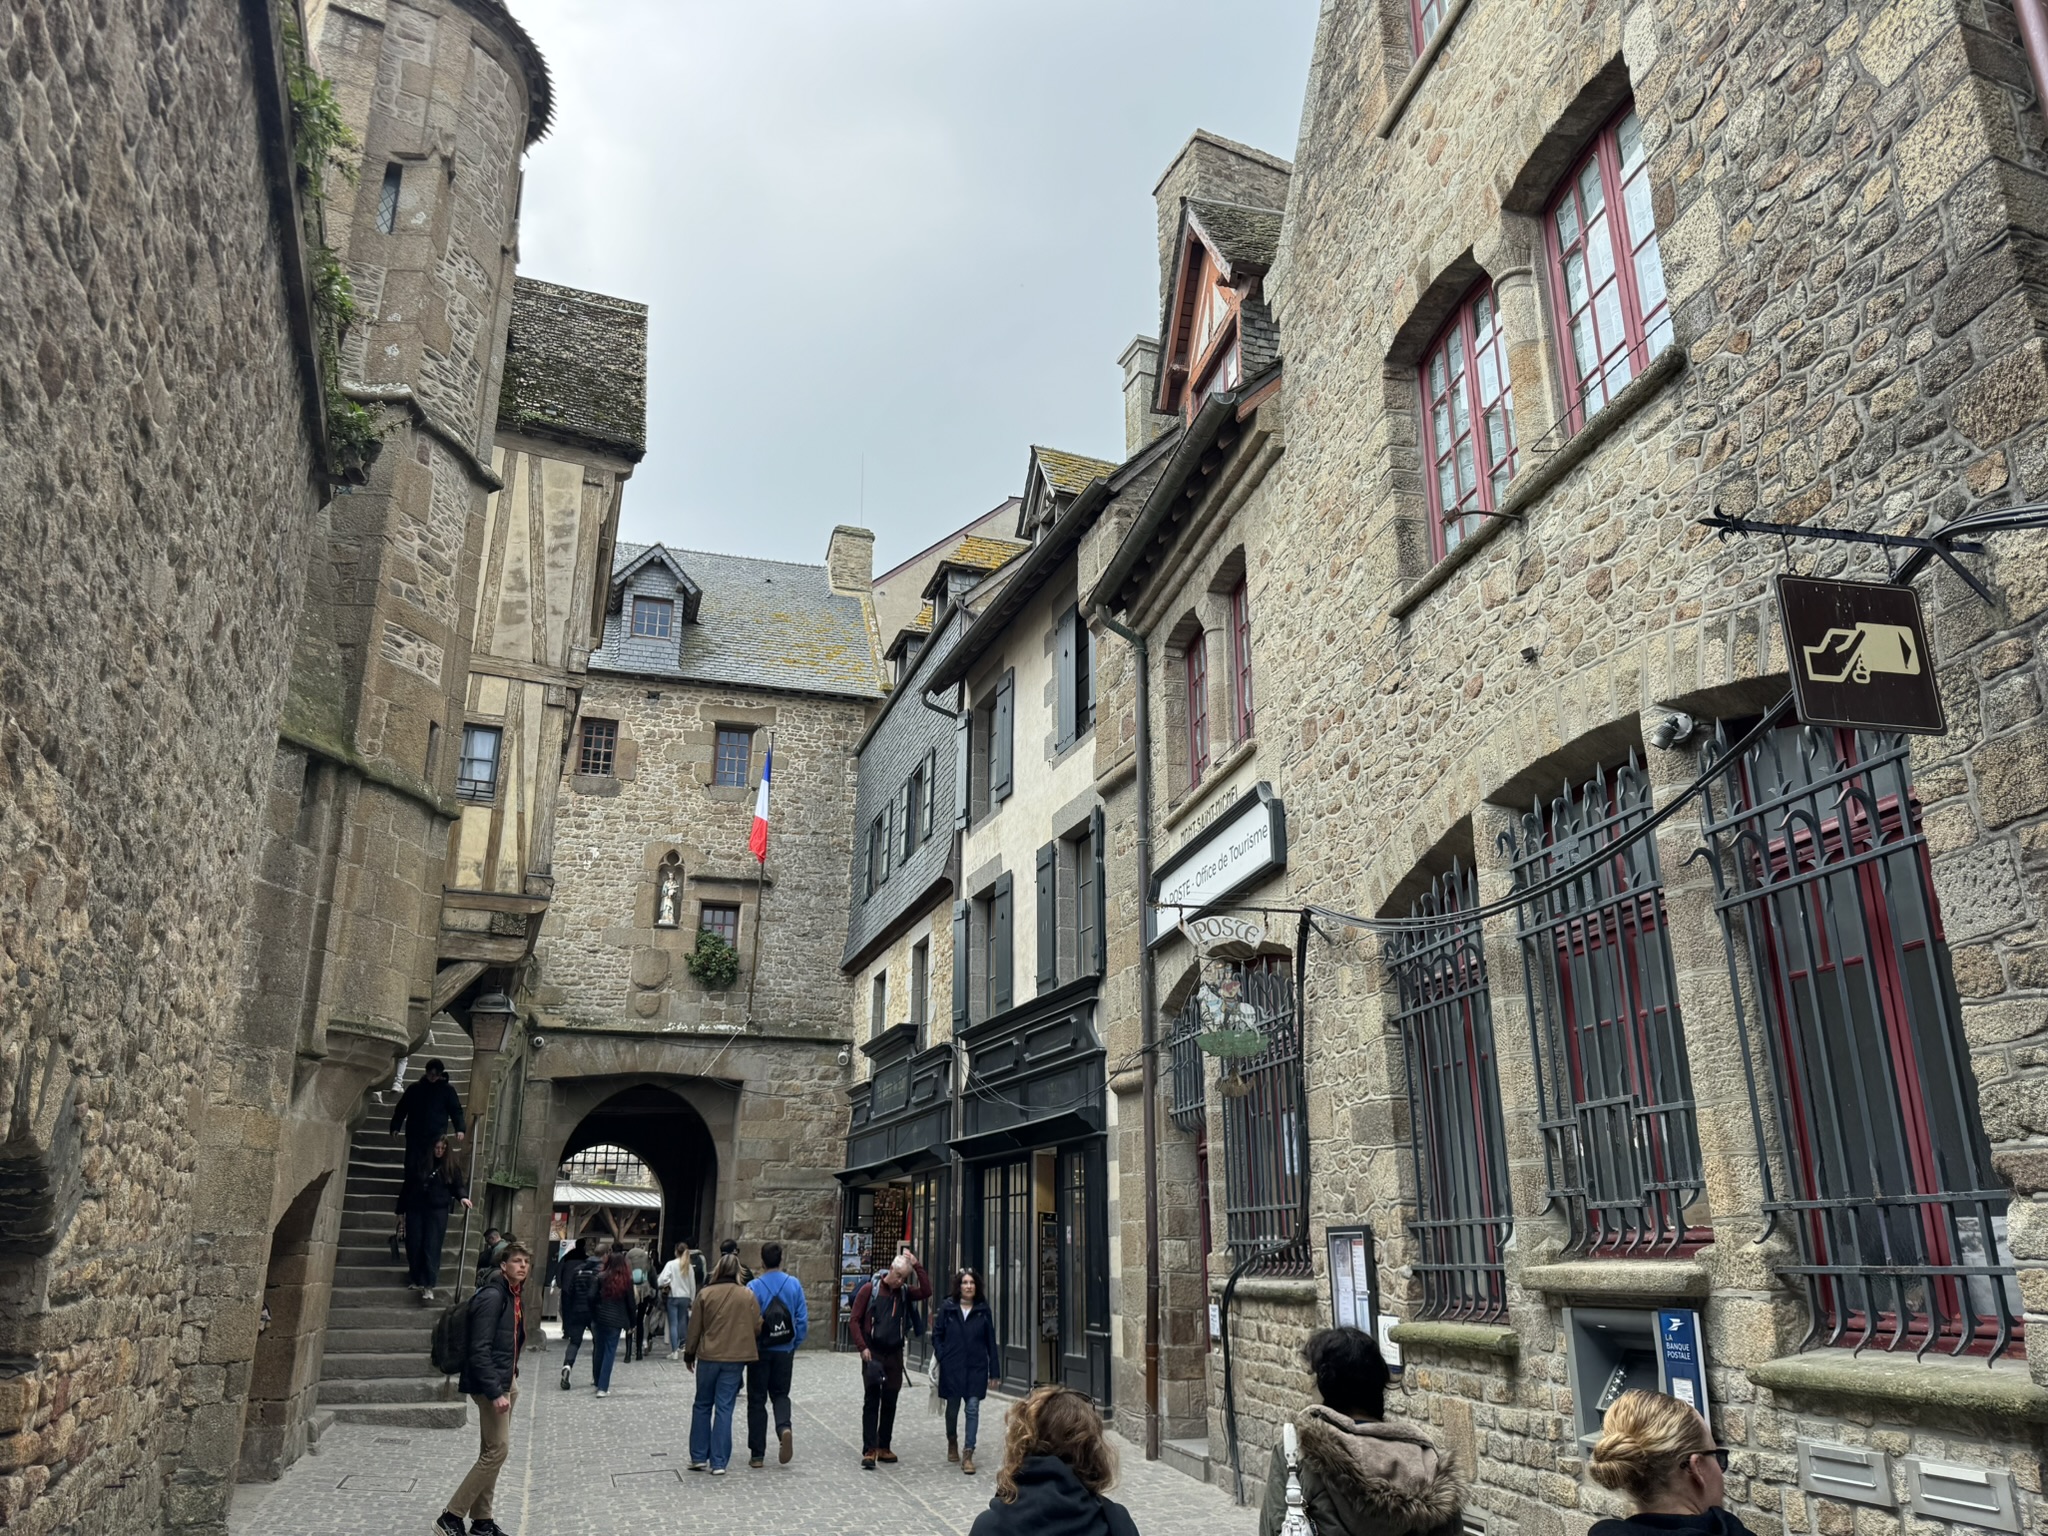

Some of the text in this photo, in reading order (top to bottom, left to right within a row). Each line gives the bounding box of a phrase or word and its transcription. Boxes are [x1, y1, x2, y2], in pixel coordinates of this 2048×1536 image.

[1169, 879, 1191, 906] POSTE
[1195, 863, 1217, 888] Office
[1217, 852, 1229, 871] de
[1229, 824, 1269, 863] Tourisme
[1191, 917, 1260, 944] POSTE
[1664, 1333, 1673, 1341] LA
[1666, 1342, 1690, 1351] BANQUE
[1667, 1351, 1691, 1360] POSTALE
